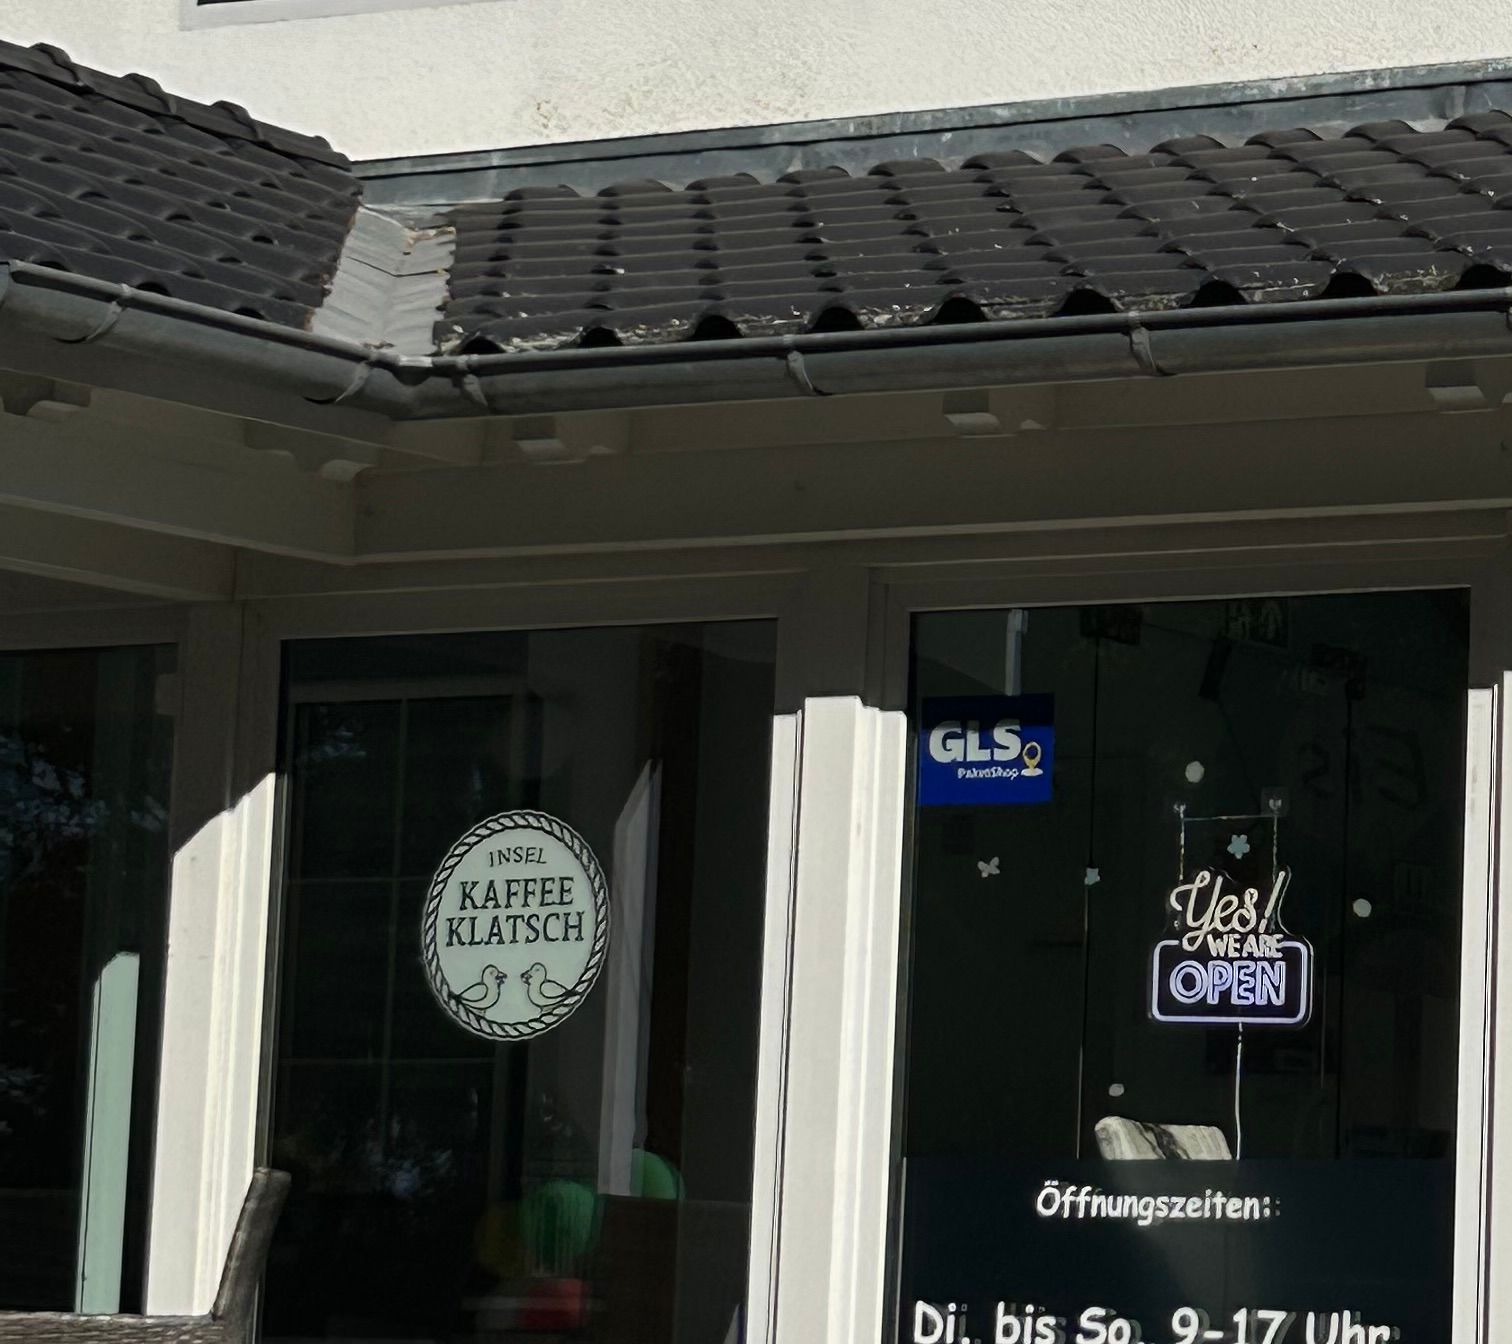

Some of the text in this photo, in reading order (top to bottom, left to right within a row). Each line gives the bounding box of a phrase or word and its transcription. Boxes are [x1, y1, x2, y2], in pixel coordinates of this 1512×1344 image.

[929, 719, 1021, 763] GLS
[489, 846, 547, 867] INSEL
[459, 876, 574, 910] KAFFEE
[1169, 870, 1286, 952] Yes!
[445, 911, 584, 947] KLATSCH
[1206, 933, 1285, 958] WE ARE
[1169, 960, 1286, 1006] OPEN
[1036, 1179, 1271, 1226] Öffnungszeiten:
